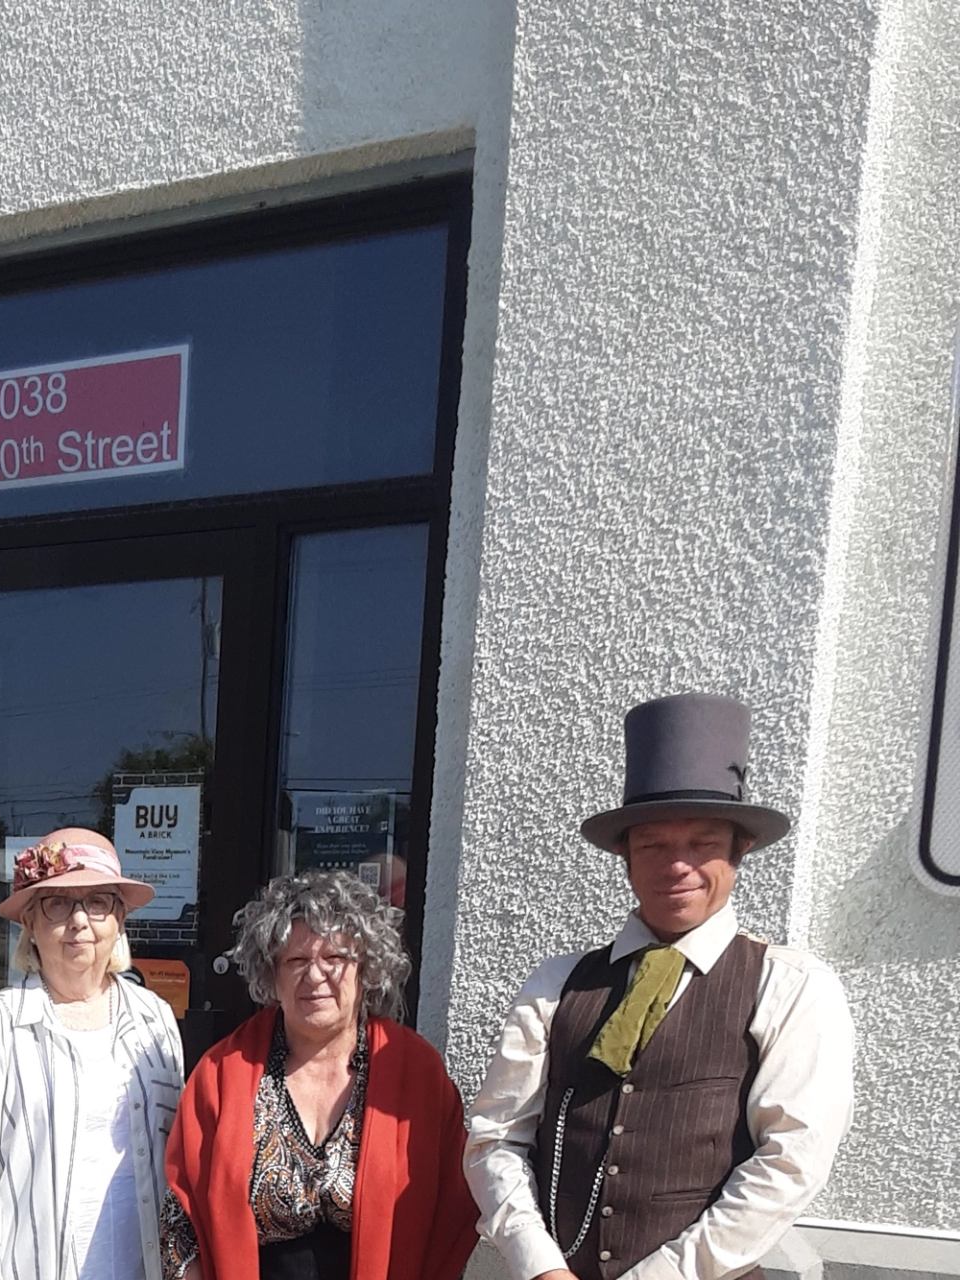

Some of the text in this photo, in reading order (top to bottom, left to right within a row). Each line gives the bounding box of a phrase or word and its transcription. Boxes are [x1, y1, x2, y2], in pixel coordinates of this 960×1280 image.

[57, 420, 172, 472] Street
[135, 804, 179, 829] BUY
[333, 815, 360, 824] GREAT
[147, 831, 173, 839] BRICK
